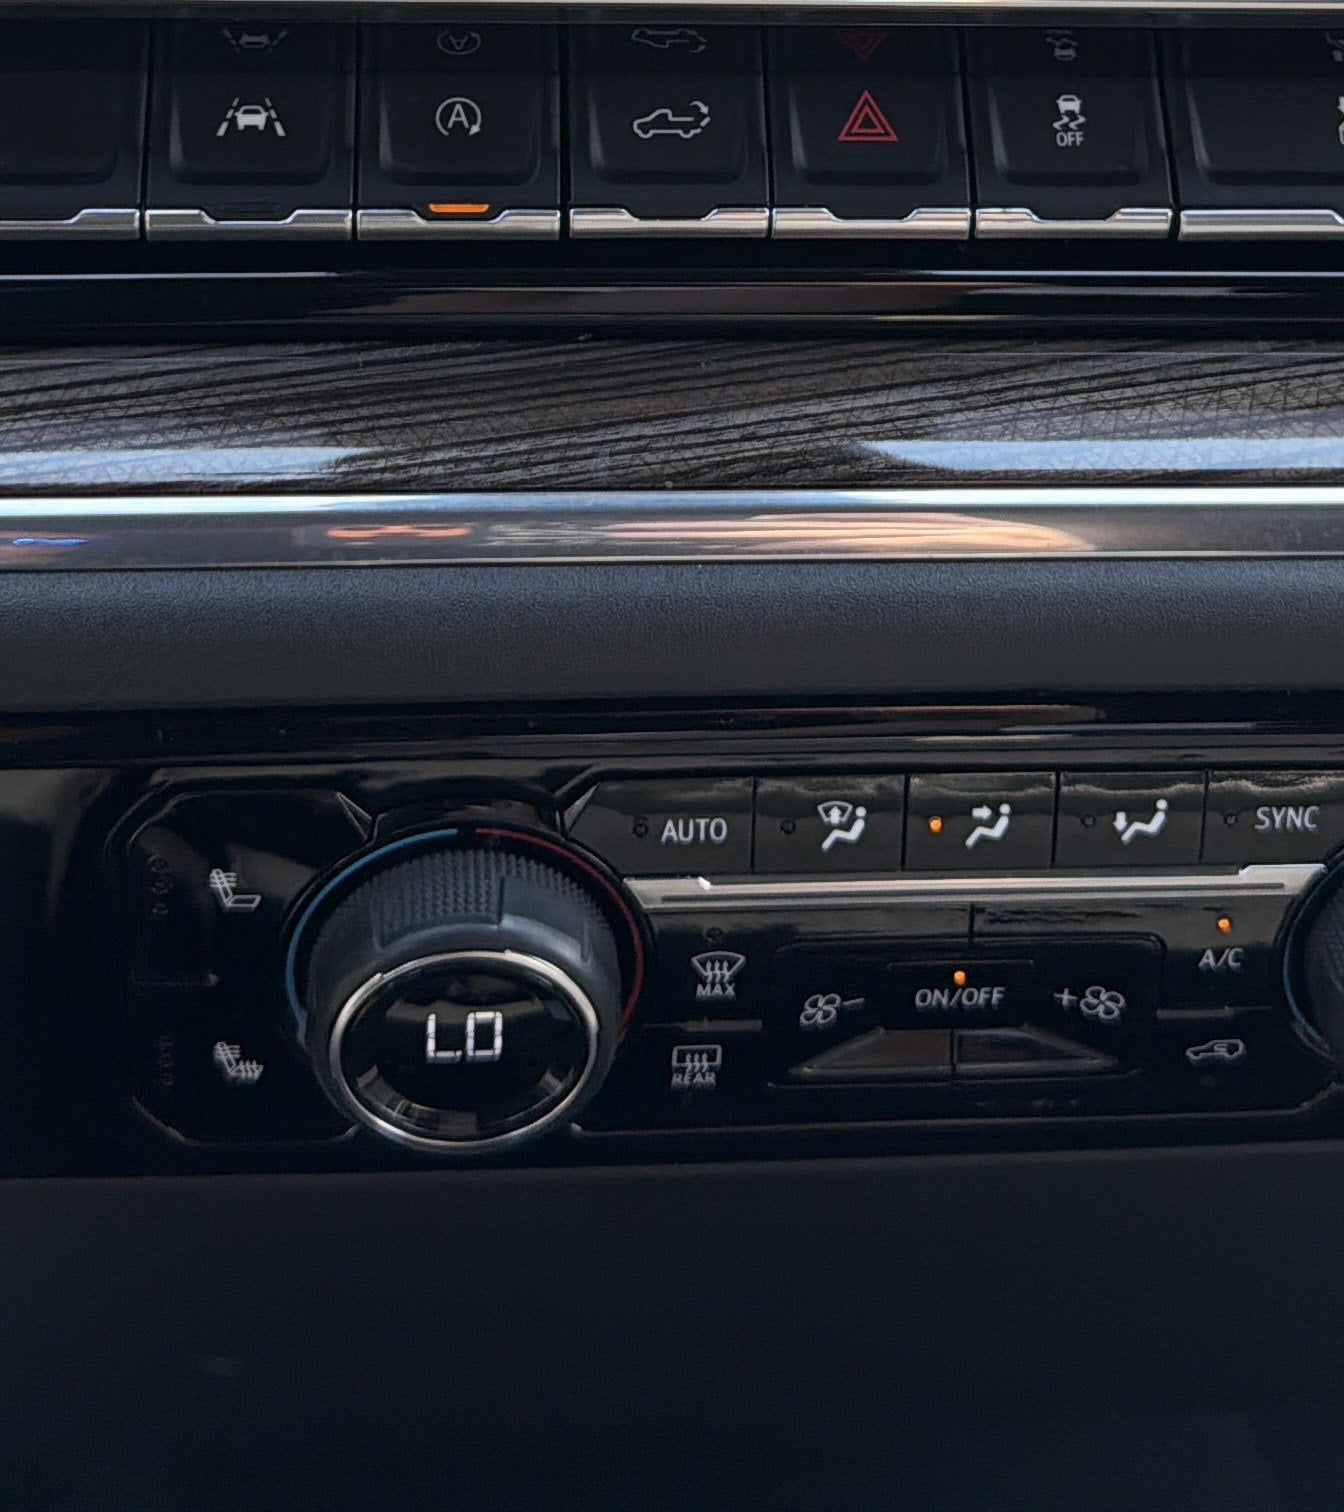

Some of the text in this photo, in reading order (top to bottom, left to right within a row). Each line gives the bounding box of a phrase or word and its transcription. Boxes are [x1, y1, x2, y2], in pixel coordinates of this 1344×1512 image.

[1056, 131, 1084, 147] OFF
[661, 817, 728, 843] AUTO
[1255, 805, 1319, 832] SYNC
[1199, 947, 1245, 971] A/C
[696, 983, 736, 1000] MAX
[914, 987, 1006, 1010] ON/OFF
[426, 1011, 503, 1062] LO
[671, 1071, 717, 1088] REAR
